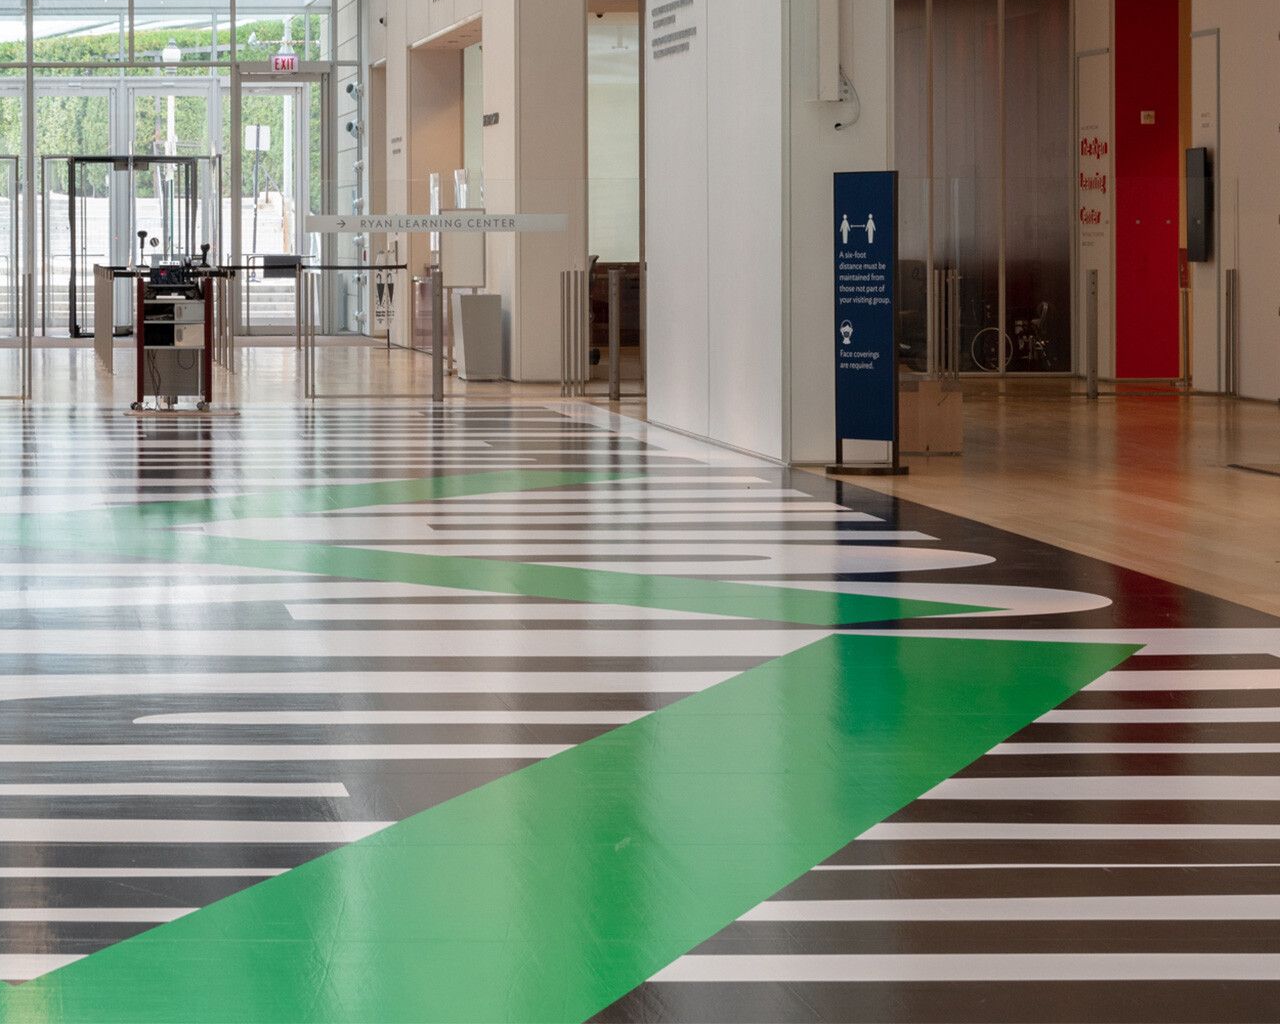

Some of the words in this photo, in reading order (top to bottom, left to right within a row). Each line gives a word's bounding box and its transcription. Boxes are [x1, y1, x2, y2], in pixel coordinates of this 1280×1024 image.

[274, 57, 295, 71] EXIT
[360, 219, 393, 228] RYAN
[398, 219, 462, 228] LEARNING
[467, 218, 516, 228] CENTER
[845, 251, 866, 259] six-foot
[839, 262, 863, 270] distance
[878, 262, 886, 270] be
[839, 273, 870, 281] maintained
[871, 273, 885, 281] from
[866, 285, 878, 294] part
[840, 296, 852, 304] your
[853, 296, 873, 306] visiting
[840, 349, 853, 357] Face
[853, 349, 880, 360] coverings
